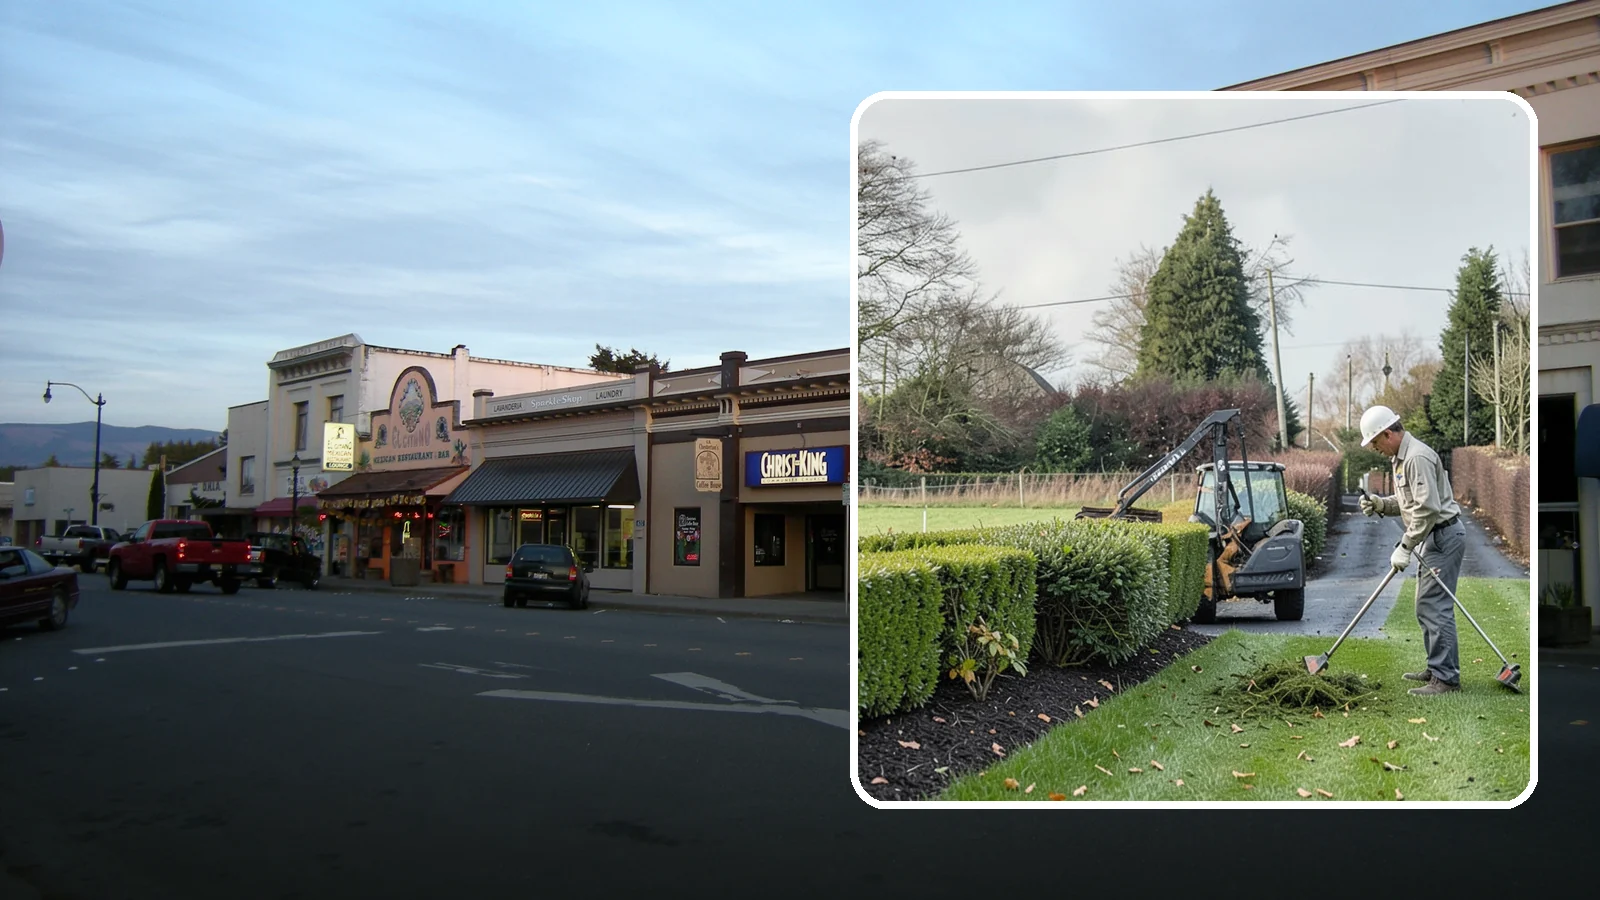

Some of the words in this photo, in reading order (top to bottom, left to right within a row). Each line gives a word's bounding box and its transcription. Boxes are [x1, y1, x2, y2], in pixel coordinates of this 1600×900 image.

[560, 395, 582, 404] Shop
[595, 388, 623, 400] LAUNDRY
[493, 401, 523, 413] LAVANDERIA
[374, 455, 396, 464] MEXICAN
[397, 451, 433, 462] RESTAURANT
[438, 450, 450, 459] BAR
[761, 452, 797, 478] CHRIST
[799, 450, 828, 476] KING
[696, 481, 709, 489] Coffee
